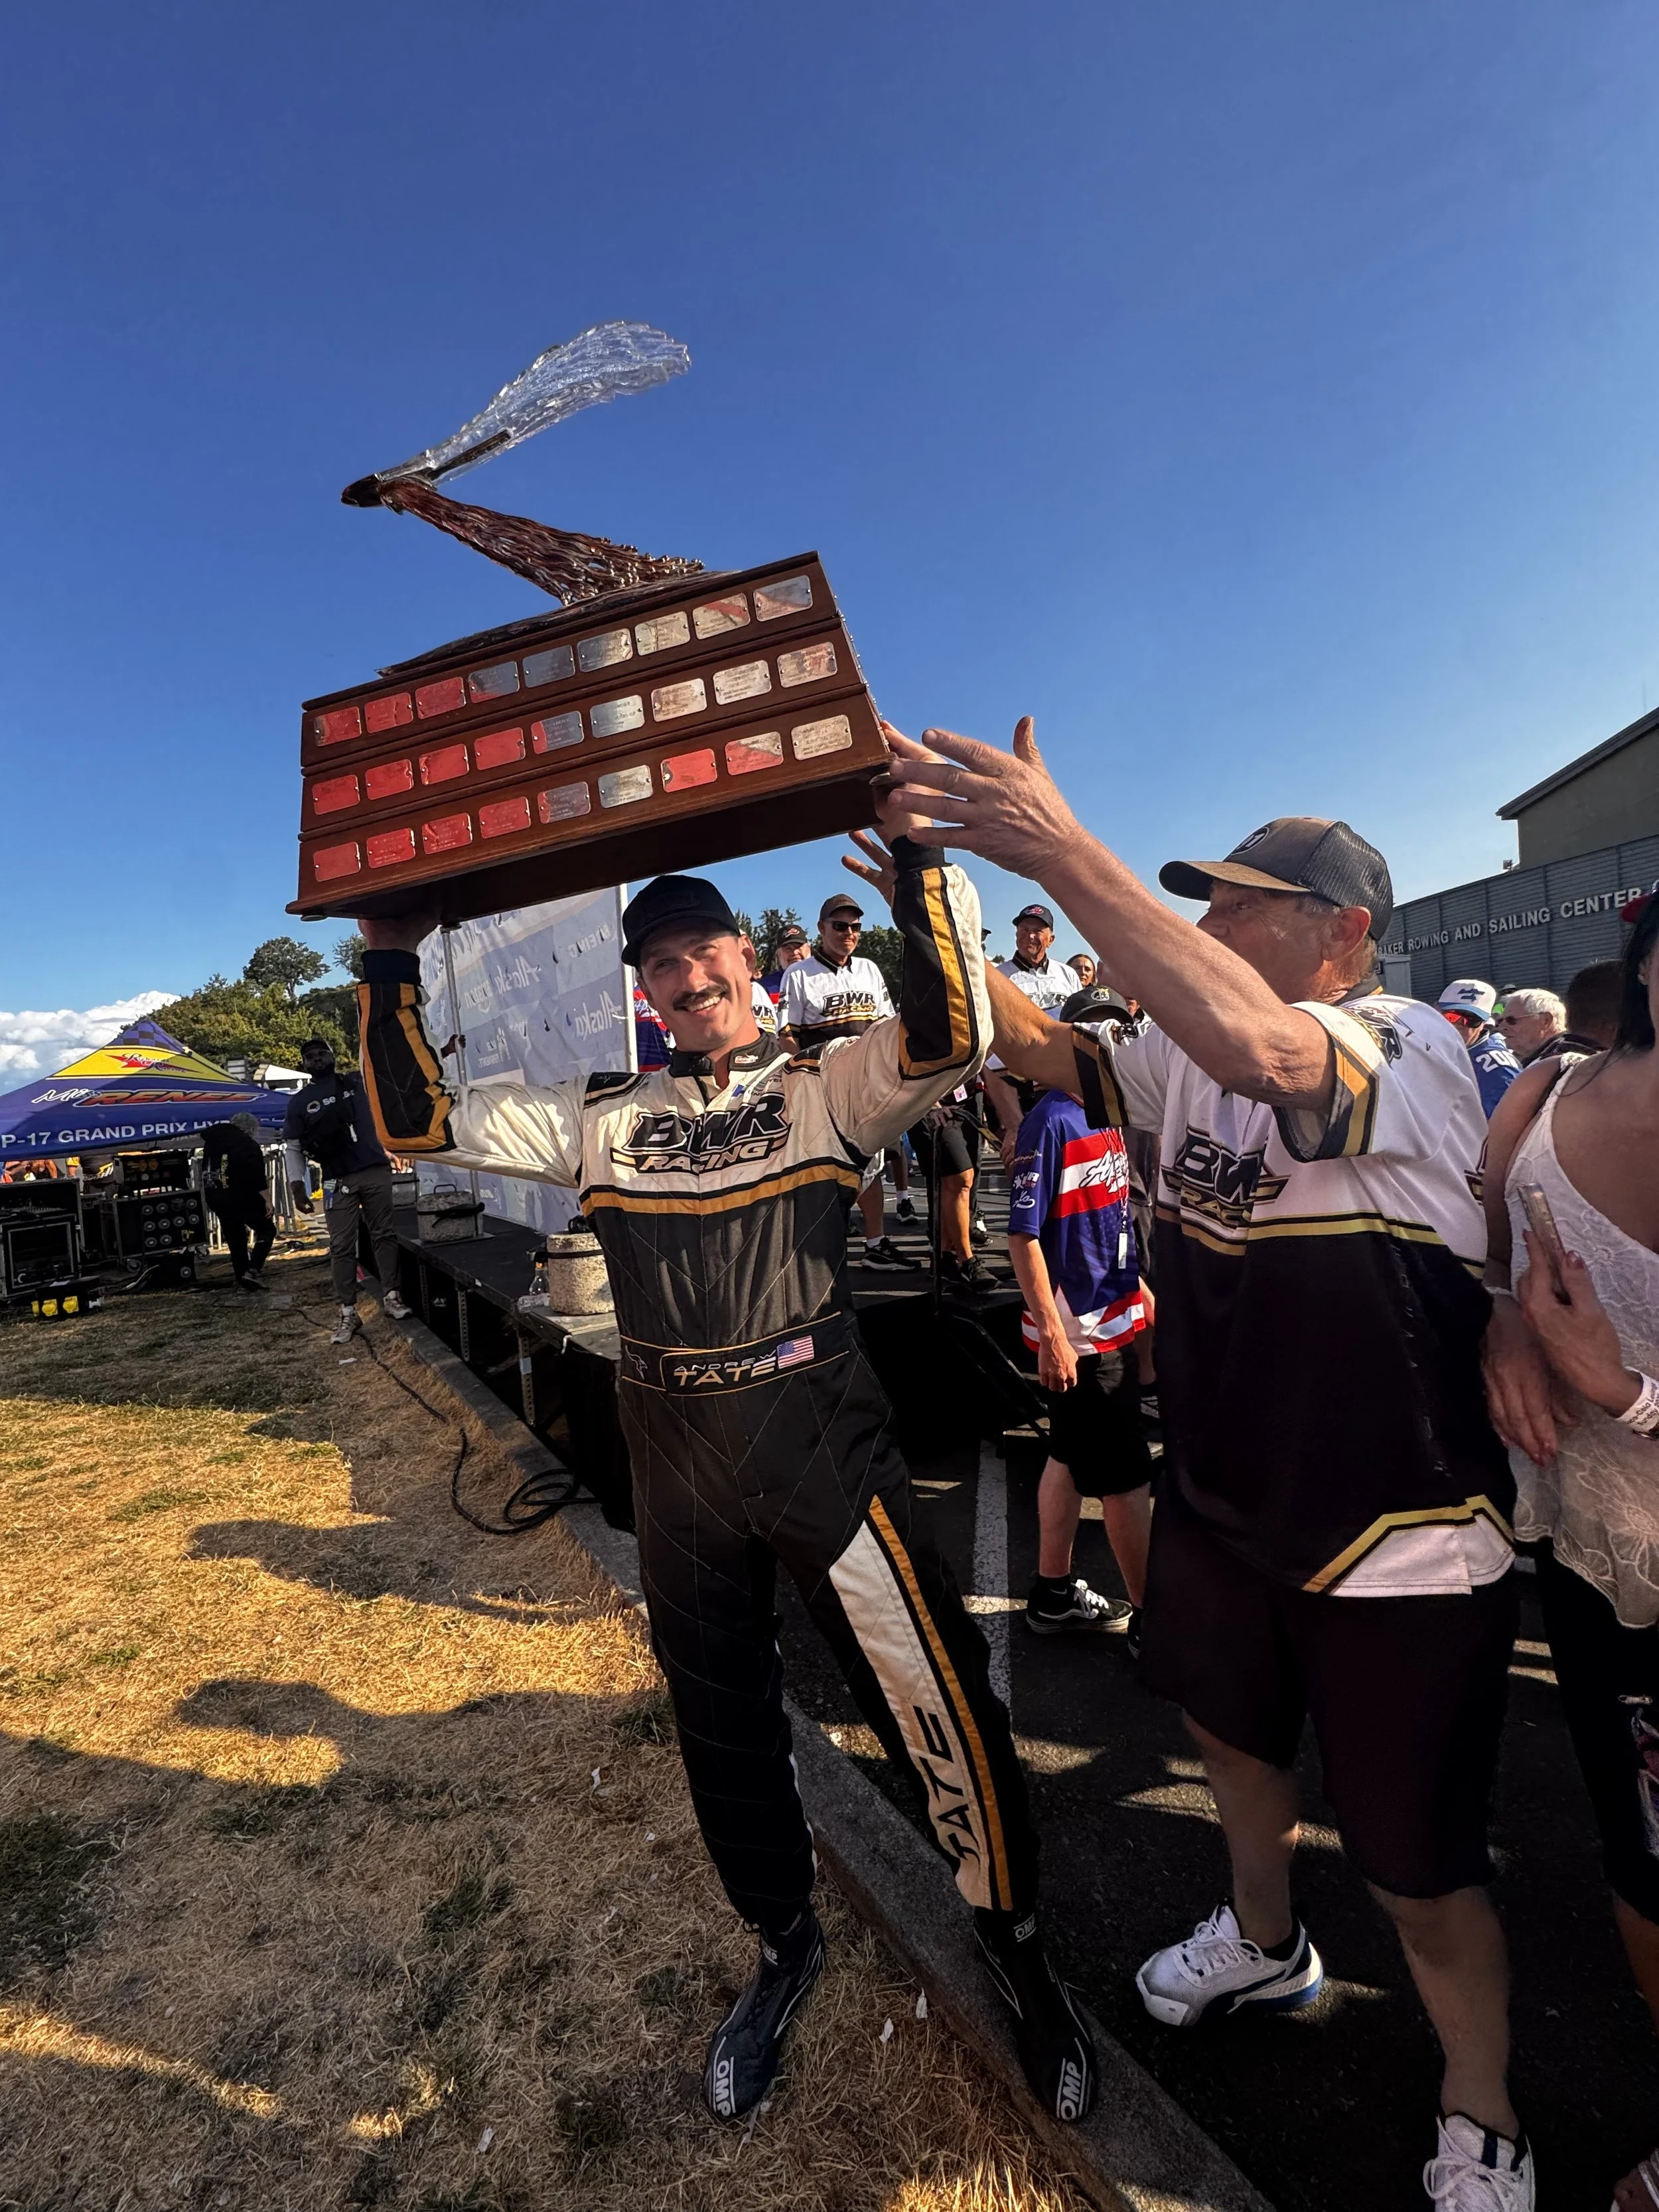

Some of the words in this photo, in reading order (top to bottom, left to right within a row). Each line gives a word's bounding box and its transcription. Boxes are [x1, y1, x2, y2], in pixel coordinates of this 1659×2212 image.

[1407, 930, 1449, 951] ROWING
[1455, 923, 1480, 940] AND
[1488, 907, 1550, 934] SAILING
[1560, 888, 1642, 919] CENTER
[823, 991, 876, 1011] BWR
[73, 1089, 267, 1107] RENEE
[58, 1126, 135, 1143] GRAND
[142, 1122, 187, 1136] PRIX
[622, 1093, 788, 1157] BWR
[639, 1140, 769, 1172] RACING
[674, 1349, 776, 1372] ANDREW
[674, 1356, 776, 1386] TATE
[913, 1704, 981, 1870] TATE
[716, 2060, 731, 2116] OMP
[1060, 2061, 1082, 2121] OMP
